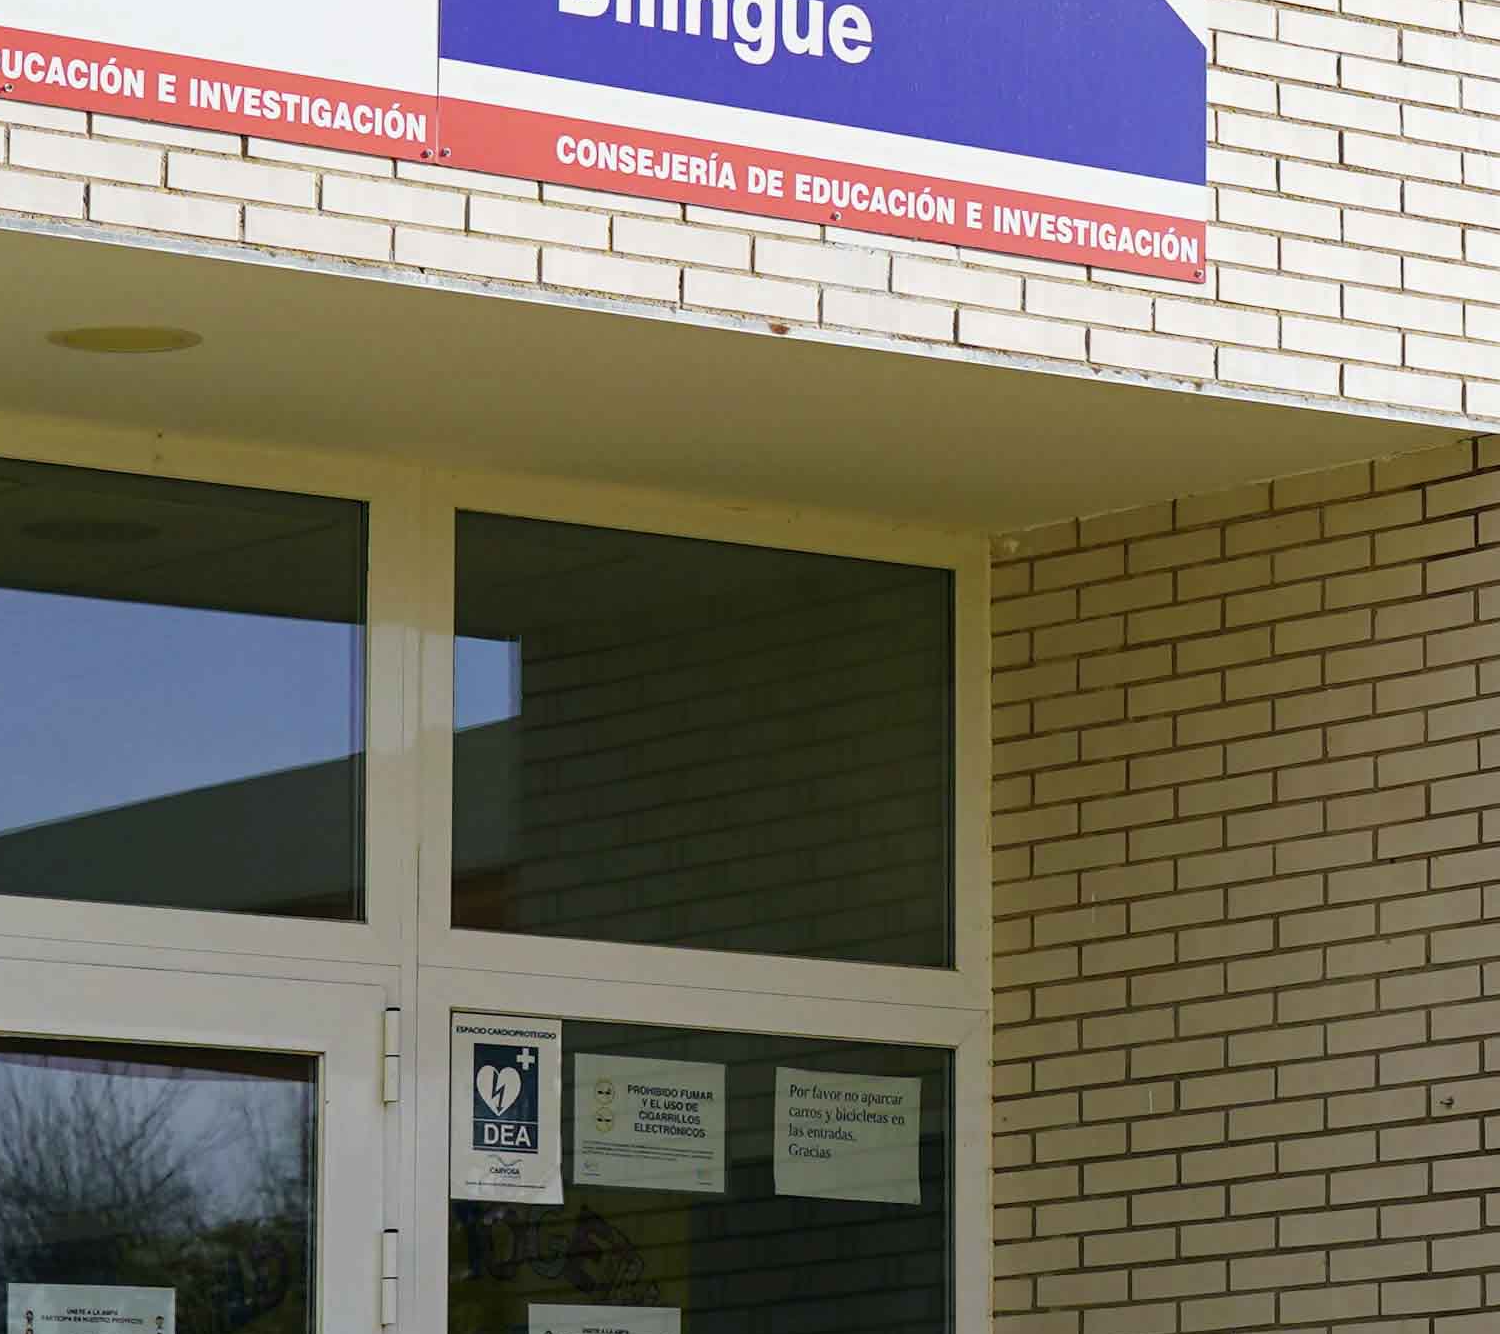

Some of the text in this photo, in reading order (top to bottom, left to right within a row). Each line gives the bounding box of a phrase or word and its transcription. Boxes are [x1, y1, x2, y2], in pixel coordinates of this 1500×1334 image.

[158, 70, 175, 102] E
[189, 77, 428, 143] INVESTIGACIÓN
[556, 135, 1200, 264] CONSEJERÍA DE EDUCACIÓN E INVESTIGACIÓN
[456, 1026, 556, 1040] ESPACIO CARDIOPROTEGIDO
[628, 1085, 713, 1100] PROHIBIDO FUMAR
[790, 1084, 903, 1107] Por favor no aparcar
[642, 1099, 698, 1112] Y EL USO DE
[639, 1111, 700, 1125] CIGARRILLOS
[789, 1107, 905, 1125] carros y bicicletas en
[483, 1124, 532, 1147] DEA
[634, 1123, 706, 1138] ELECTRÓNICOS
[788, 1123, 804, 1136] las
[788, 1143, 832, 1158] Gracias
